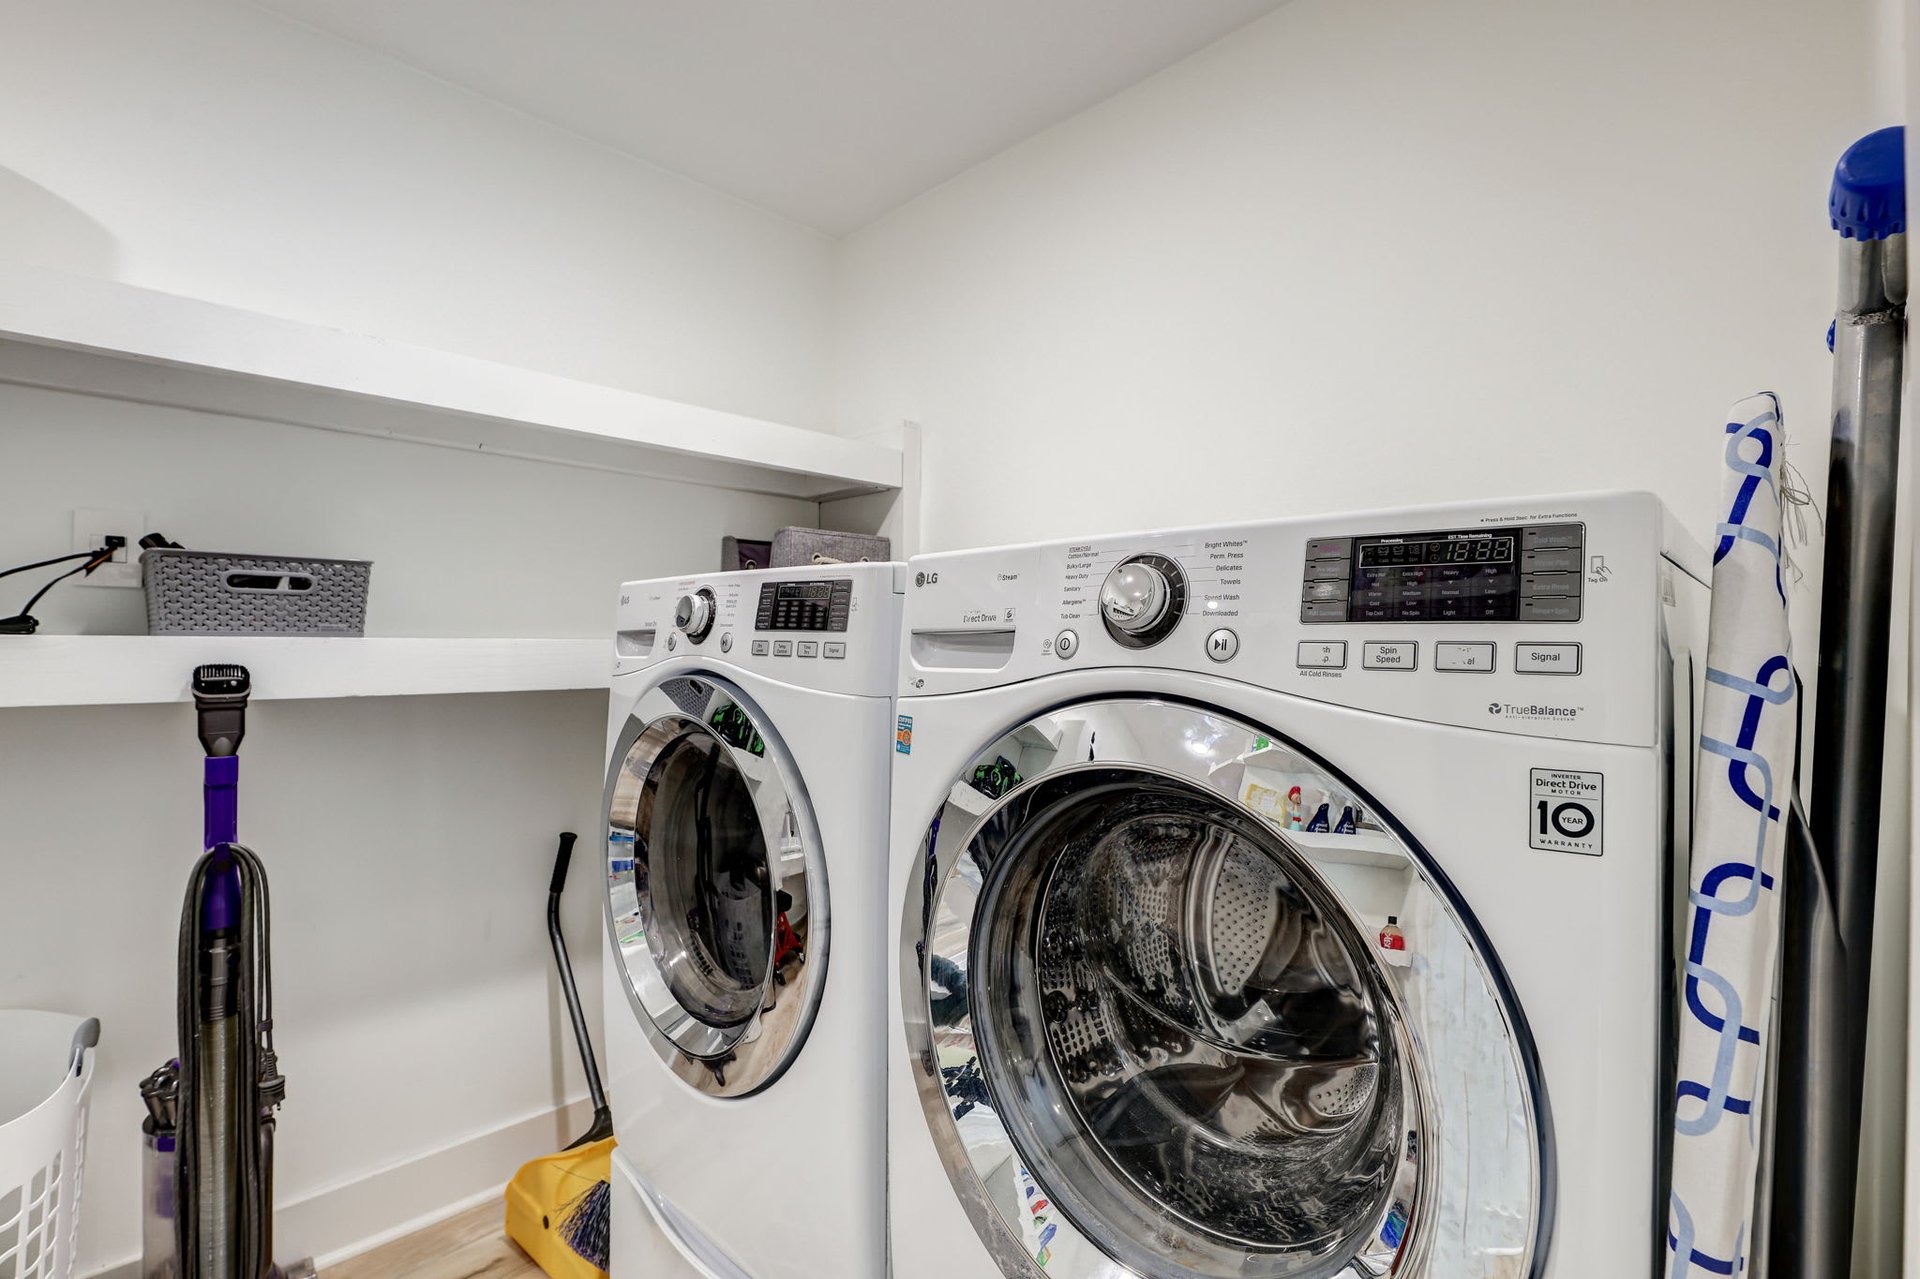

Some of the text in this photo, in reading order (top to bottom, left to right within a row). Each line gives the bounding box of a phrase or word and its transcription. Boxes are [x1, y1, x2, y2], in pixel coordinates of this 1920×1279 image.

[926, 573, 938, 585] LG
[981, 614, 997, 622] Drive
[1380, 647, 1398, 655] Spin
[1376, 655, 1401, 664] Speed
[1531, 653, 1561, 663] Signal
[1536, 779, 1597, 791] Direct Drive
[1537, 800, 1595, 839] 10
[1562, 817, 1584, 825] YEAR
[1540, 839, 1593, 849] WARRANTY
